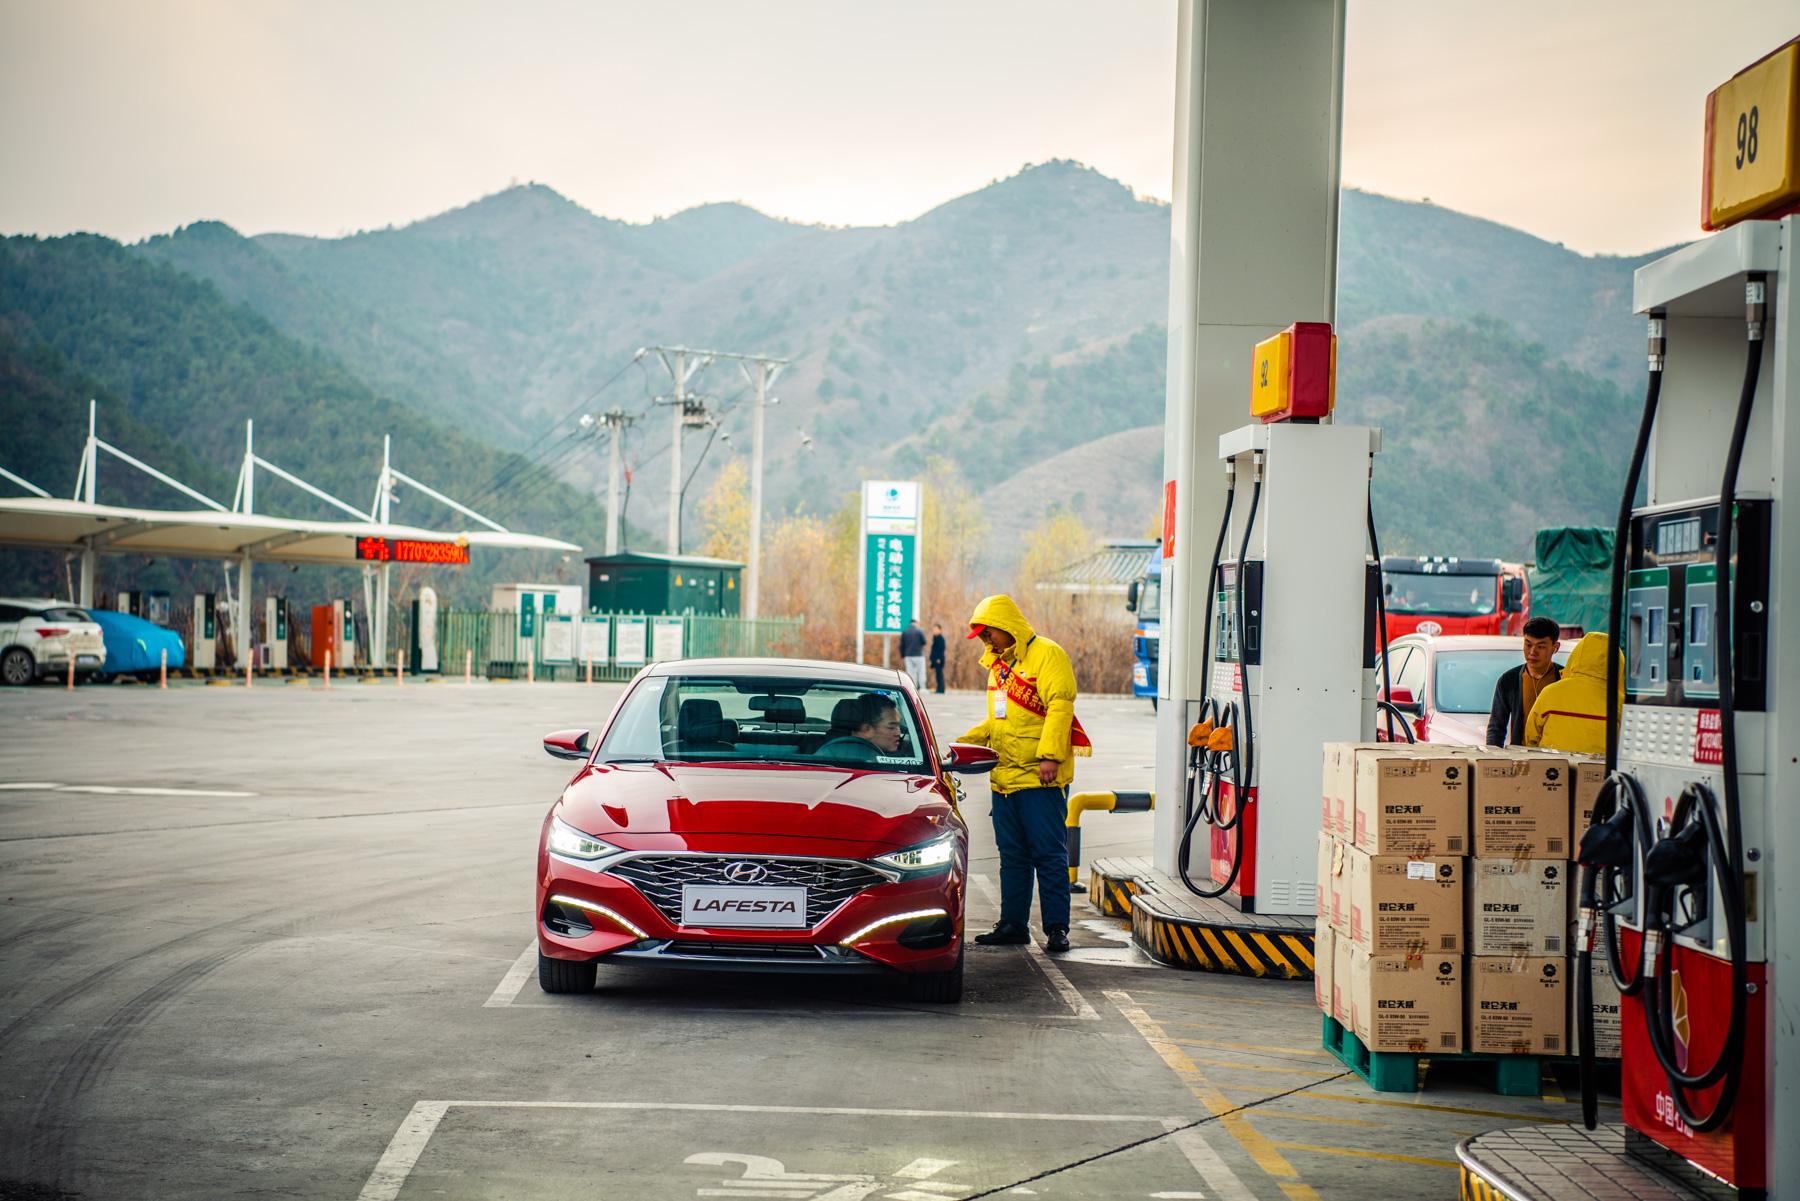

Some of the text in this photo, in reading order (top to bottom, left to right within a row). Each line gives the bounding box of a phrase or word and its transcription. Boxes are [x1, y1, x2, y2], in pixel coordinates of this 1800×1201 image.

[1735, 105, 1759, 170] 98
[692, 898, 796, 913] LAFESTA
[1592, 1004, 1618, 1014] 仑天威
